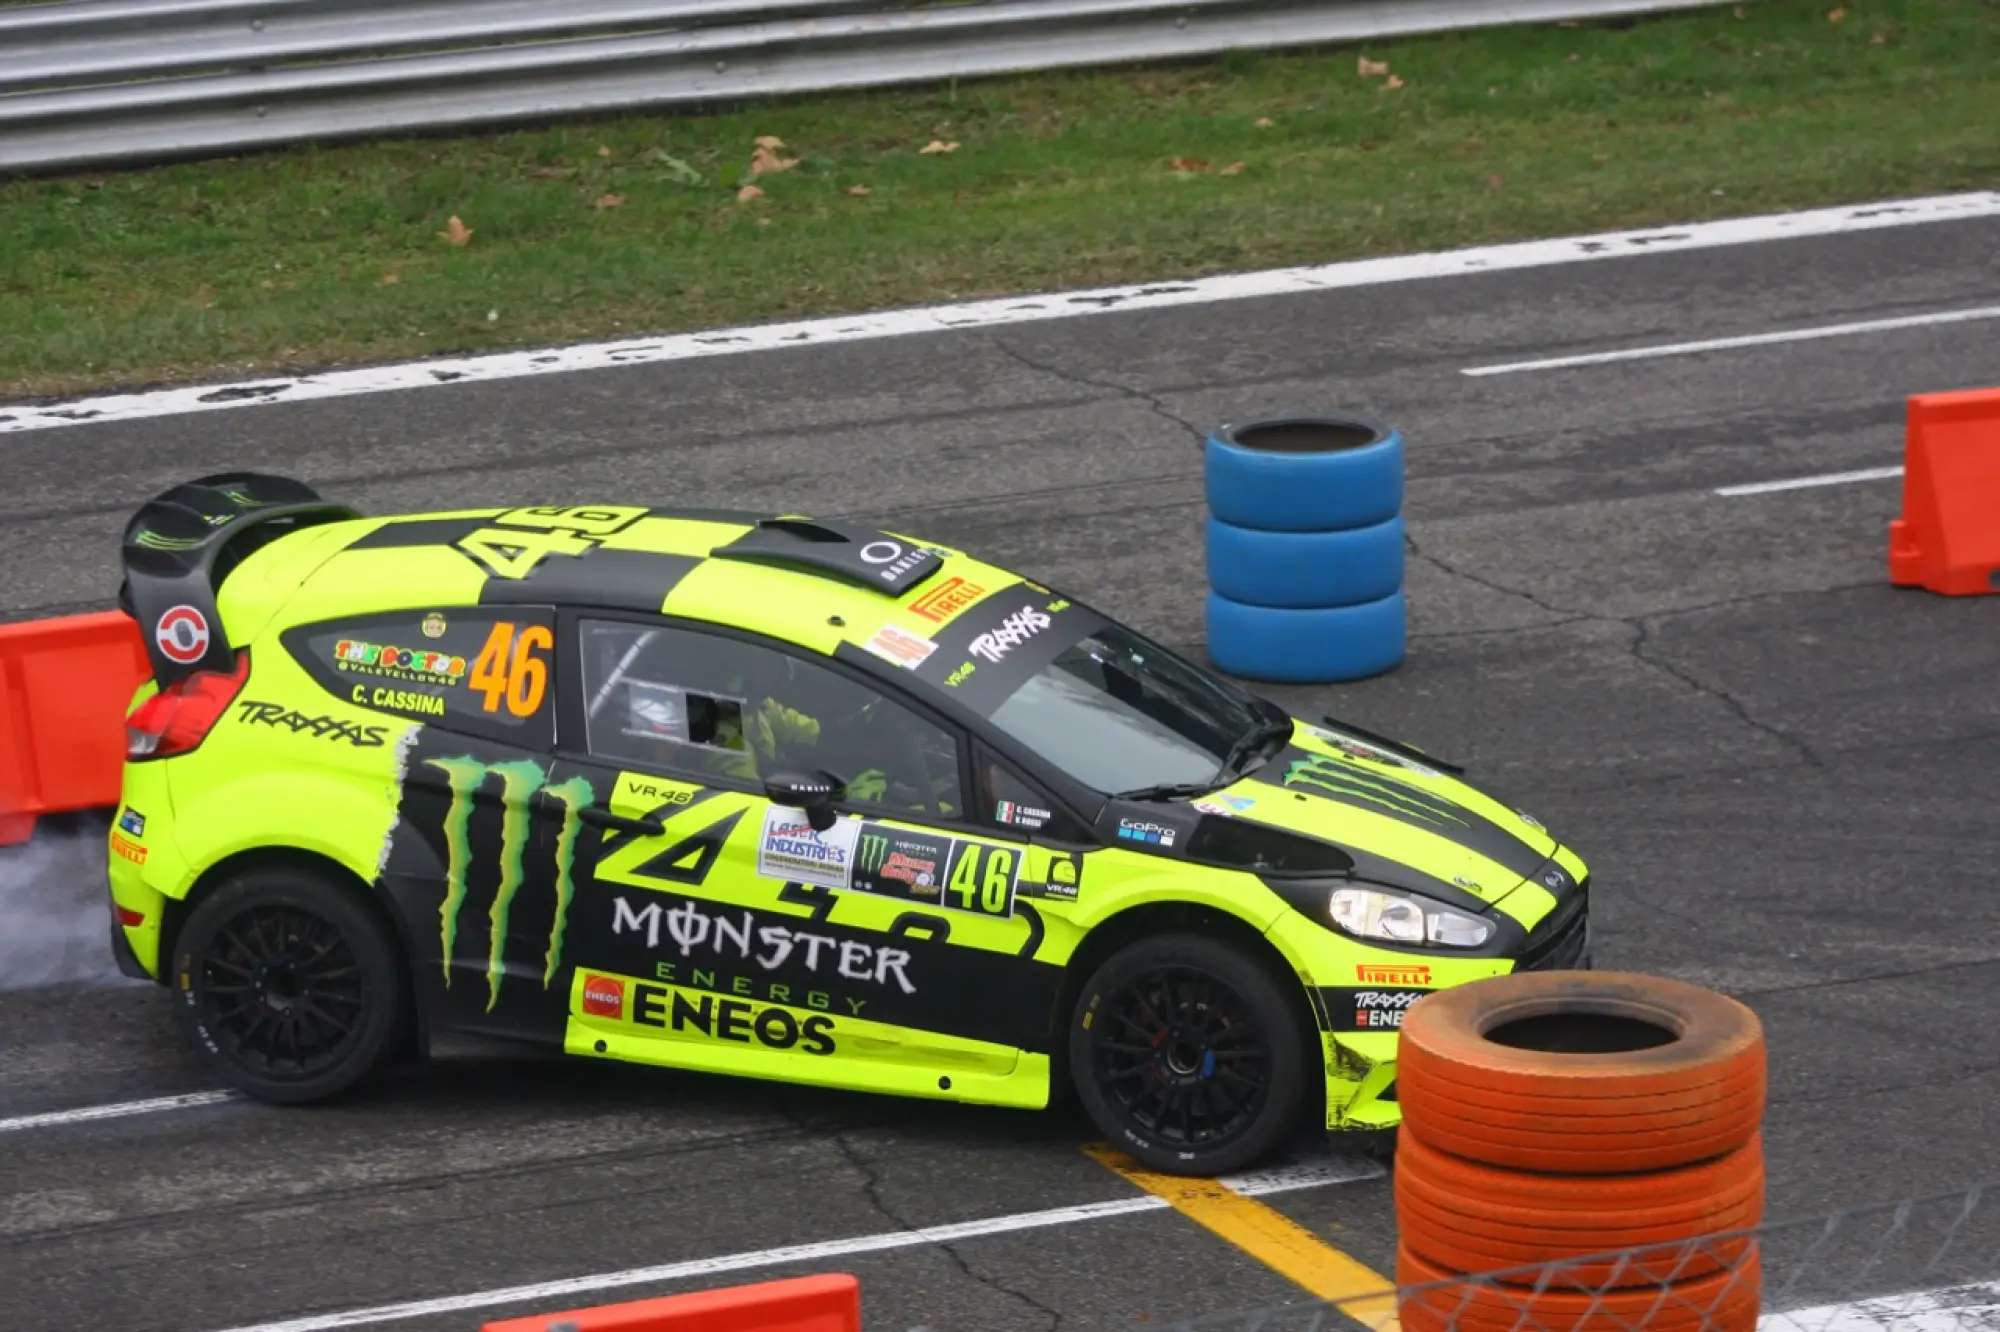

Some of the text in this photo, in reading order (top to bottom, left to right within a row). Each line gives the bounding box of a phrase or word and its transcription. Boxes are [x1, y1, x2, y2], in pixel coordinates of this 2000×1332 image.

[879, 546, 935, 582] OAKLEY
[908, 576, 986, 623] PIRELLI
[968, 604, 1051, 663] TRAXXAS
[334, 639, 466, 678] THE DOCTOR
[467, 619, 554, 719] 46
[238, 700, 390, 747] TRAXXAS
[352, 684, 445, 716] C. CASSINA
[1119, 817, 1177, 837] GoPro
[949, 844, 1012, 914] 46
[611, 897, 917, 994] MONSTER
[585, 990, 620, 1005] ENEOS
[655, 961, 868, 1017] ENERGY
[1356, 964, 1431, 985] PIRELLI
[632, 983, 838, 1056] ENEOS
